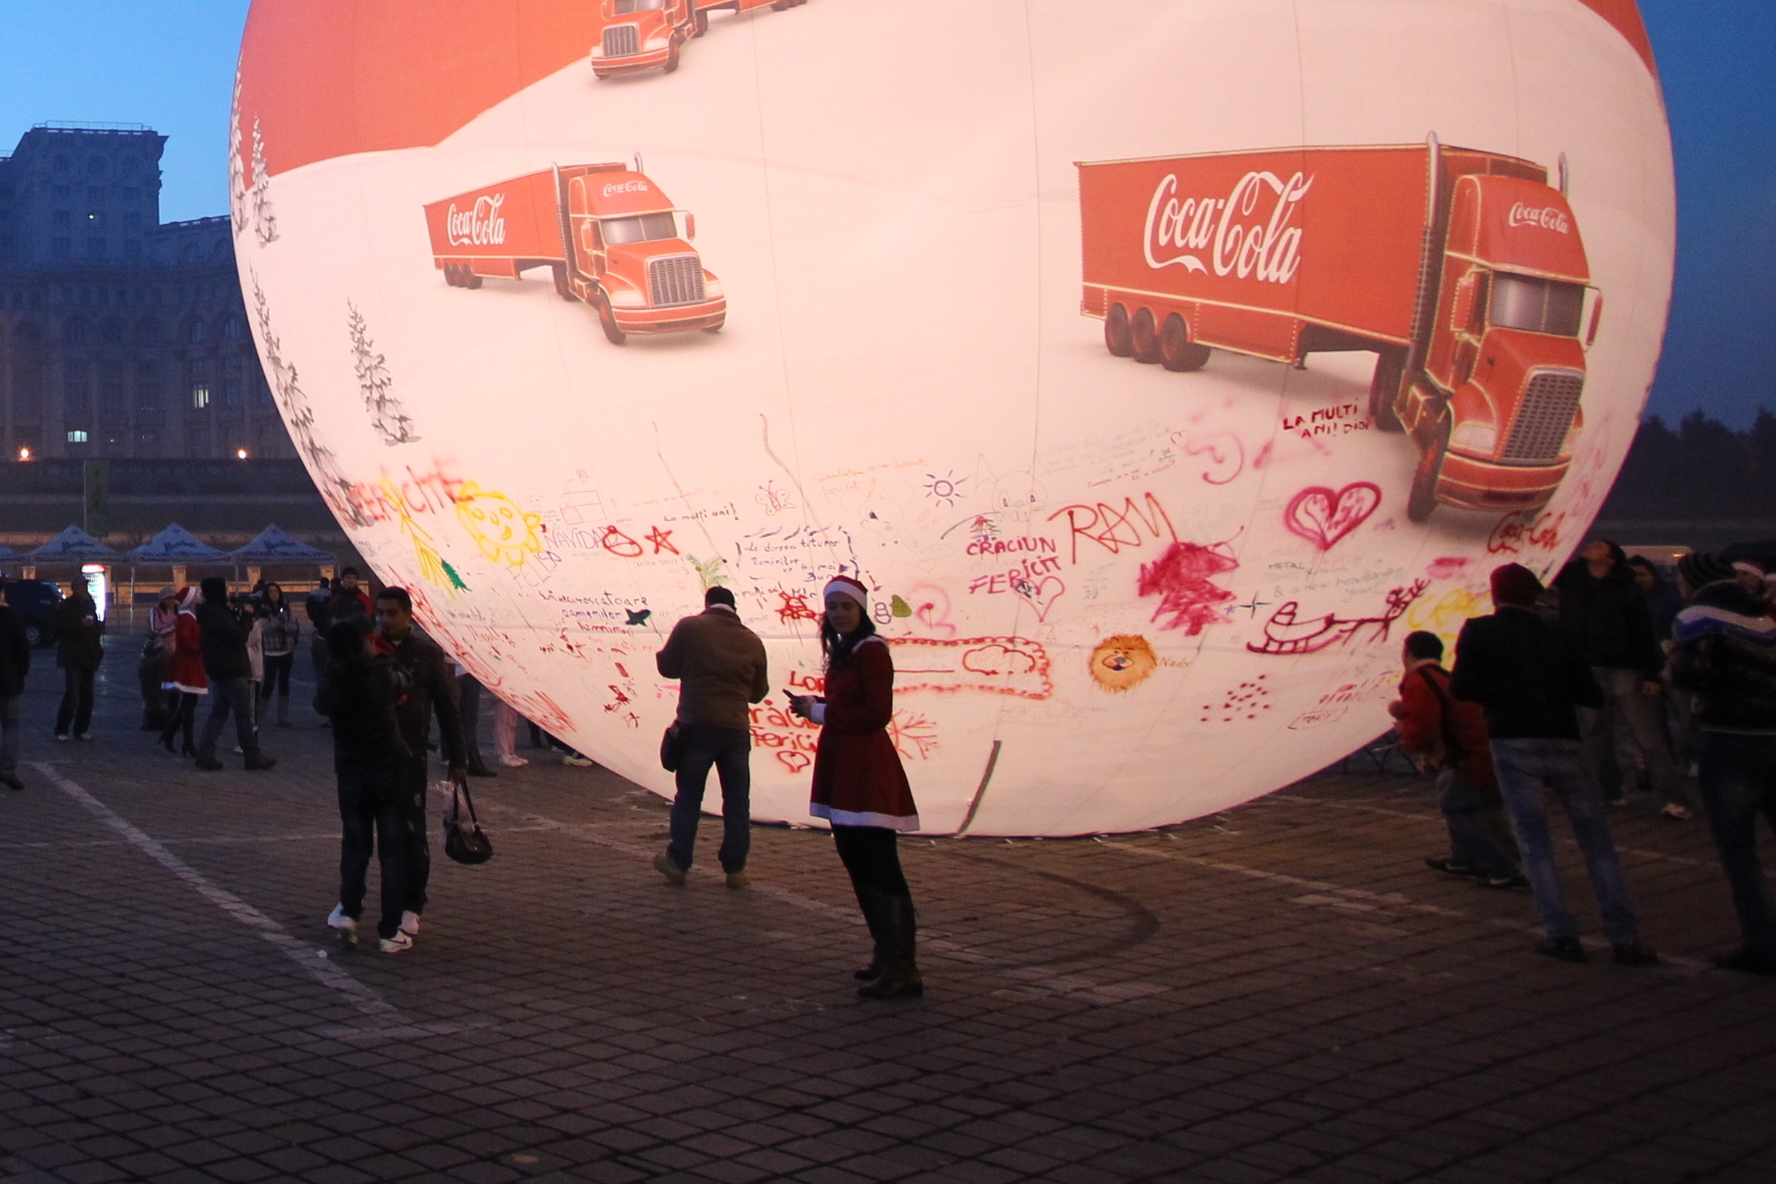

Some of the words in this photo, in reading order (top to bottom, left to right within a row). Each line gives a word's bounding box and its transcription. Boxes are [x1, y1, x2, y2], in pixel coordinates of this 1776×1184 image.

[603, 180, 648, 197] Coca-Cola
[447, 193, 505, 246] Coca-Cola
[1143, 170, 1315, 284] Coca-Cola
[1508, 201, 1568, 235] Coca-Cola
[1283, 416, 1305, 430] LA
[966, 536, 1056, 556] CRACIUN
